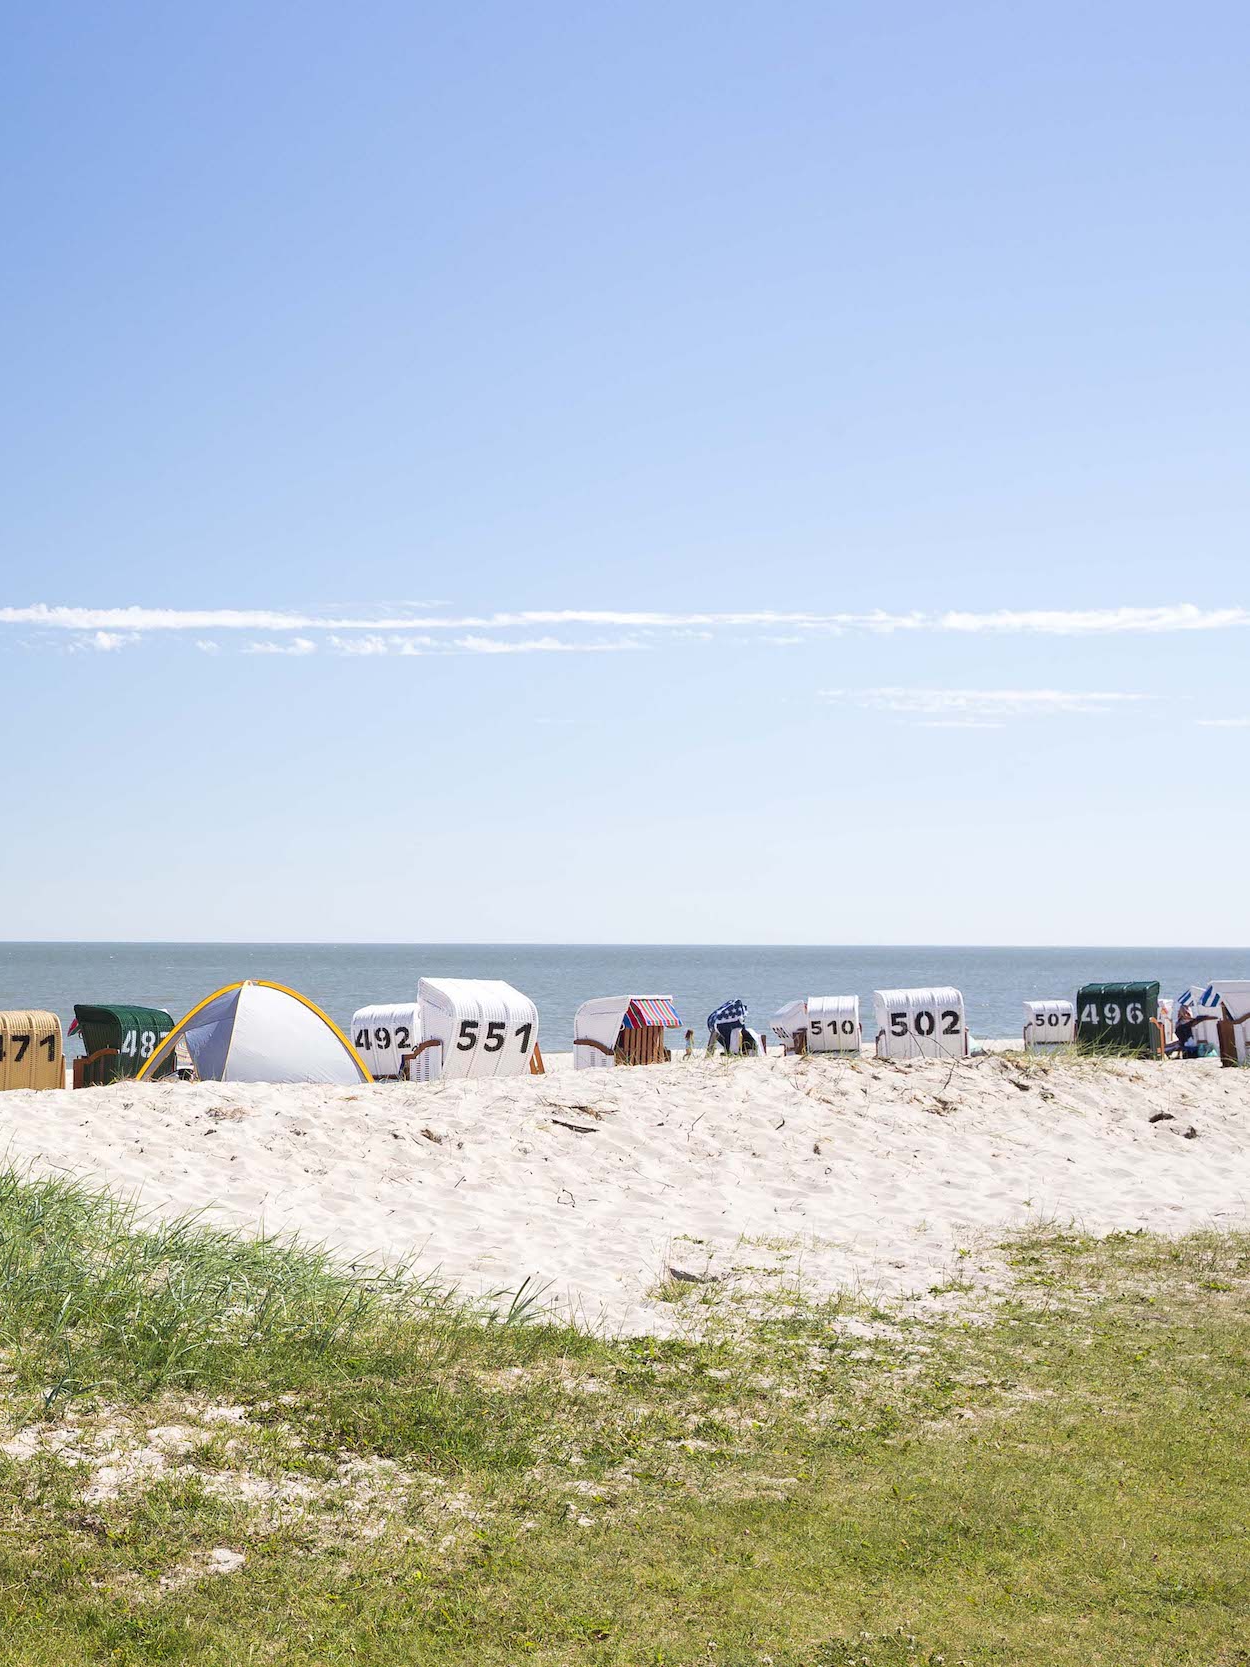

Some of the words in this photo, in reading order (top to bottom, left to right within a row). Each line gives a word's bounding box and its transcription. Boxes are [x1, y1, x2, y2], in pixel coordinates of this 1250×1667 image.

[891, 1011, 960, 1036] 502
[1036, 1013, 1071, 1026] 507
[1081, 1004, 1144, 1024] 496
[457, 1020, 531, 1053] 551
[811, 1020, 854, 1035] 510
[355, 1027, 411, 1050] 492
